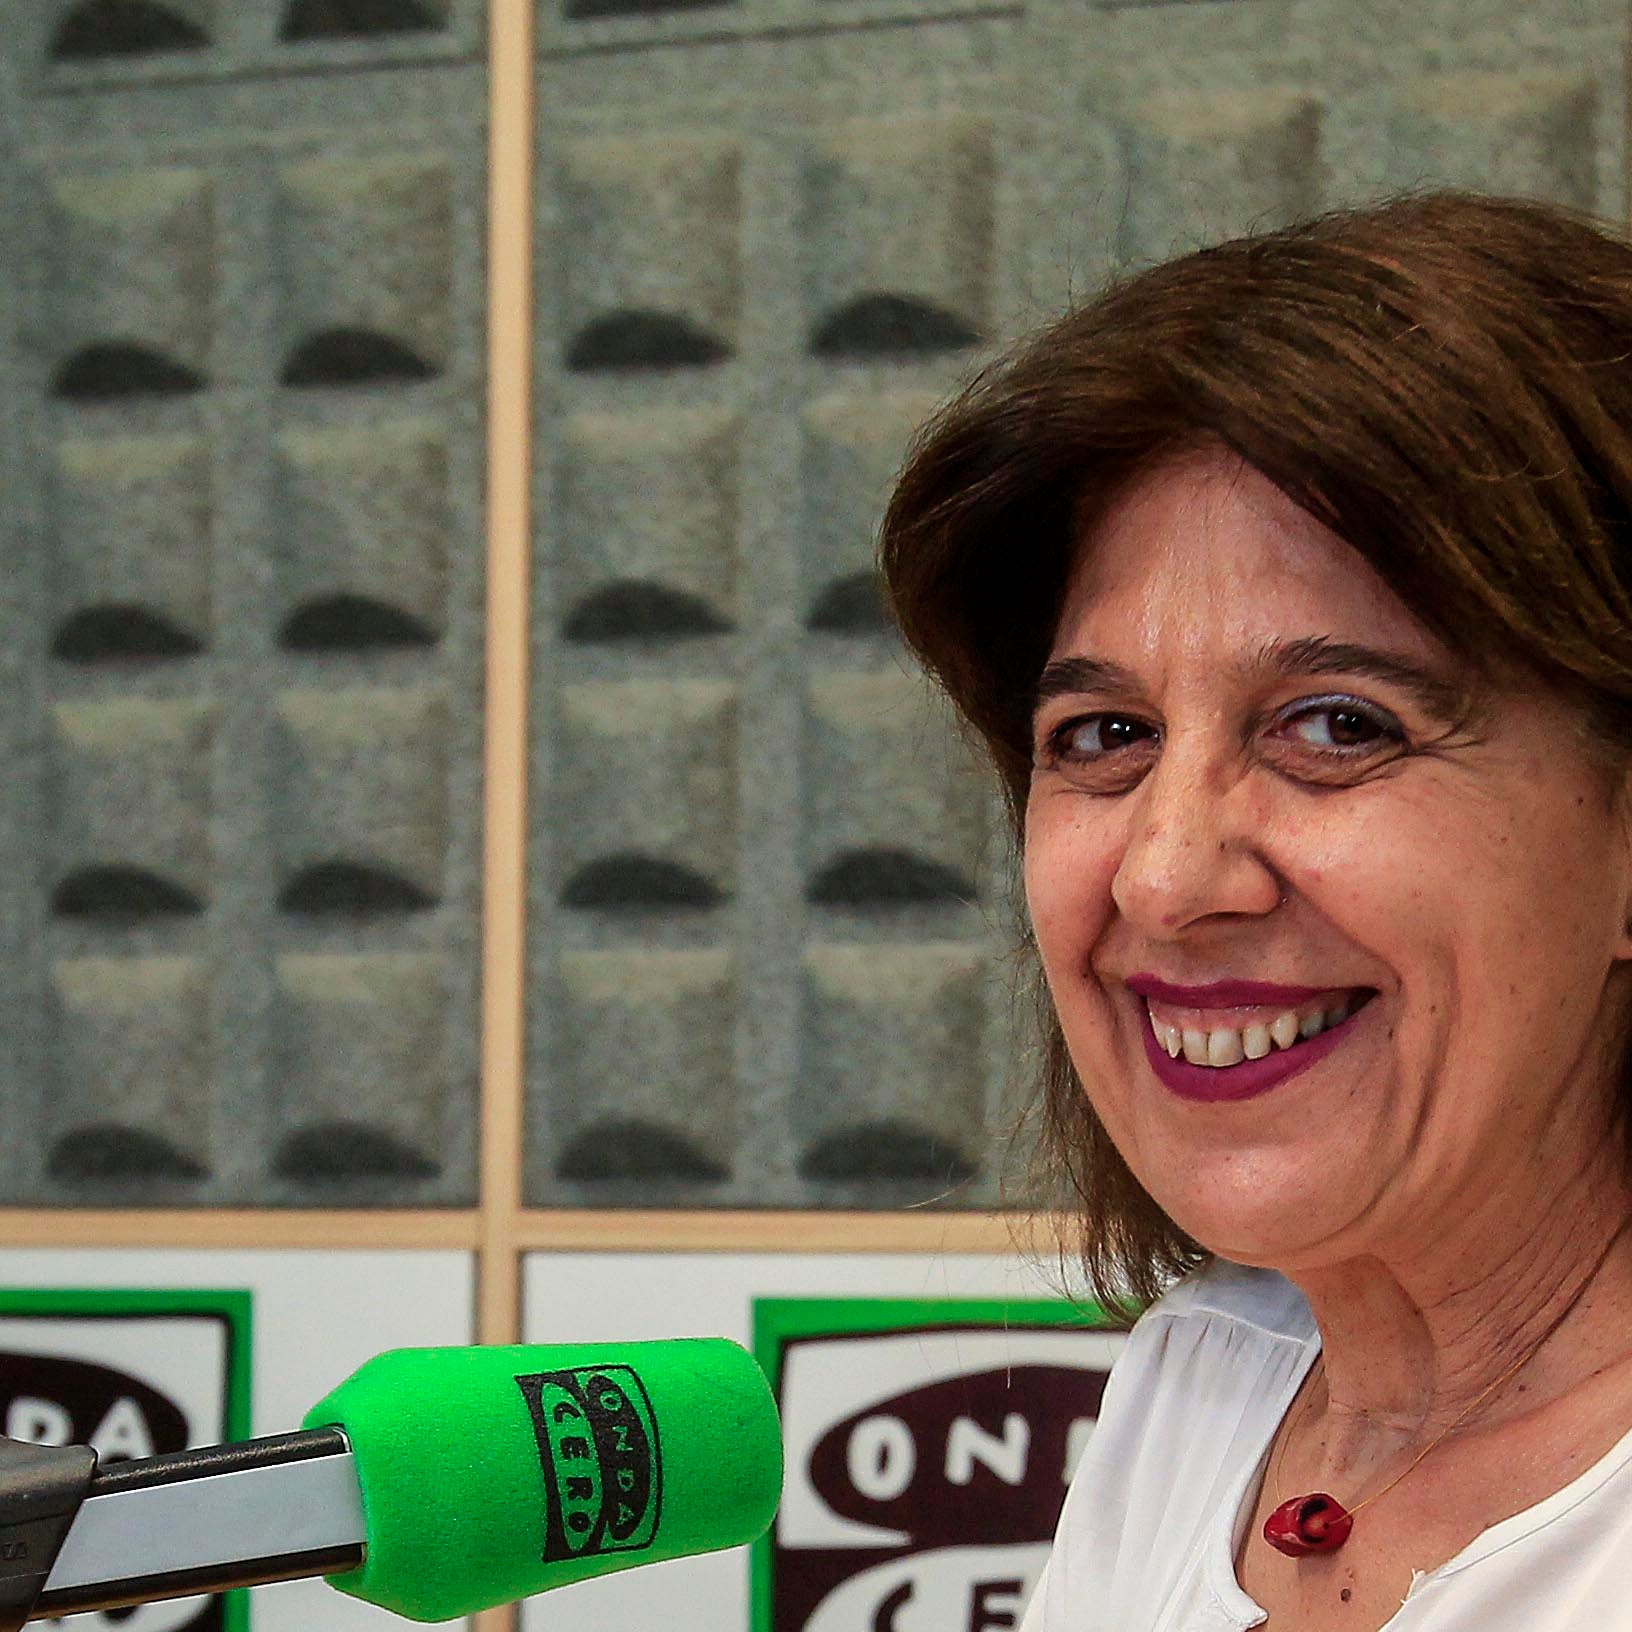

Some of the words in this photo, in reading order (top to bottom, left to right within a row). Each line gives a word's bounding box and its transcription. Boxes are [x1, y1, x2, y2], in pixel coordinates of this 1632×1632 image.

[553, 1401, 594, 1533] CERO
[598, 1389, 636, 1527] ONDA
[846, 1412, 1099, 1502] ON
